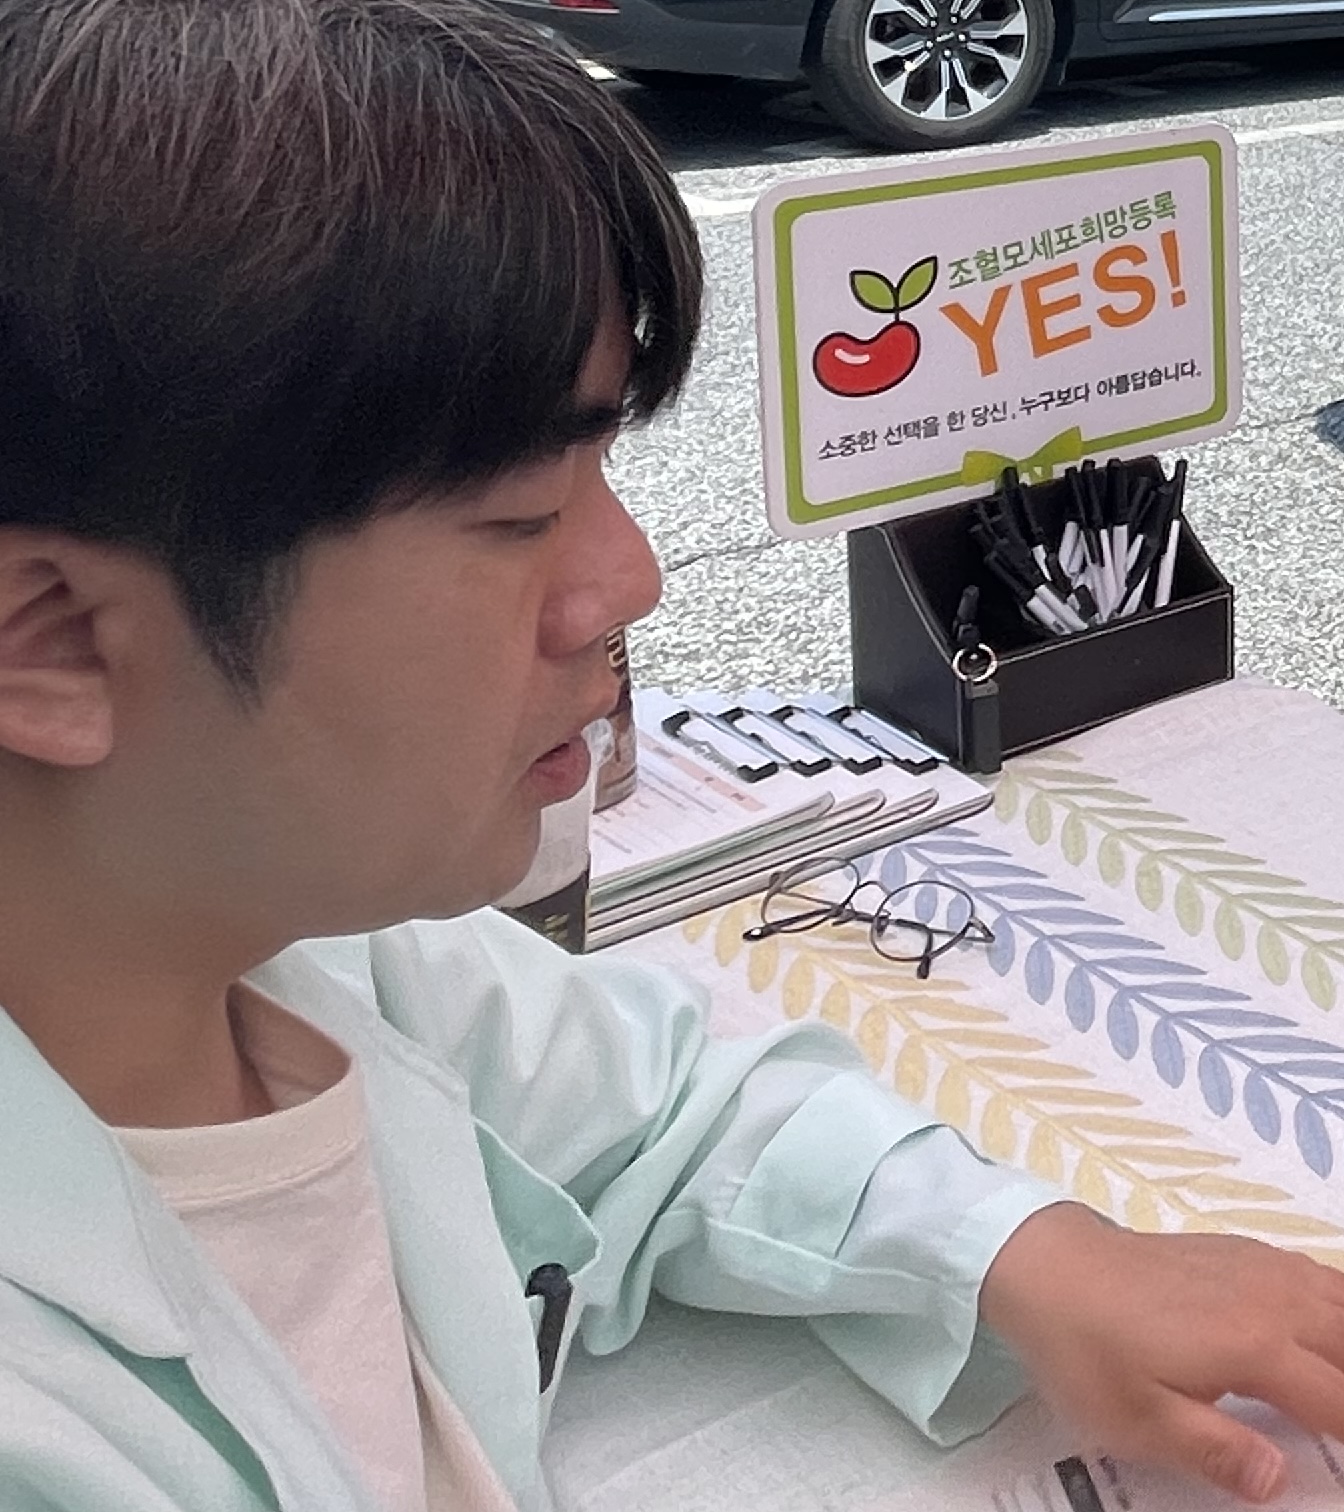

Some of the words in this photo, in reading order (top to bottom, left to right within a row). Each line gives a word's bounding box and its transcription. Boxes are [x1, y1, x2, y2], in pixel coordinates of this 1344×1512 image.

[947, 191, 1178, 290] 조혈모세포희망등록
[940, 230, 1189, 378] YES!
[818, 431, 878, 462] 소중한
[883, 417, 940, 446] 선택을
[946, 410, 967, 433] 한
[1019, 386, 1091, 416] 누구보다
[1097, 360, 1203, 399] 아름답습니다.
